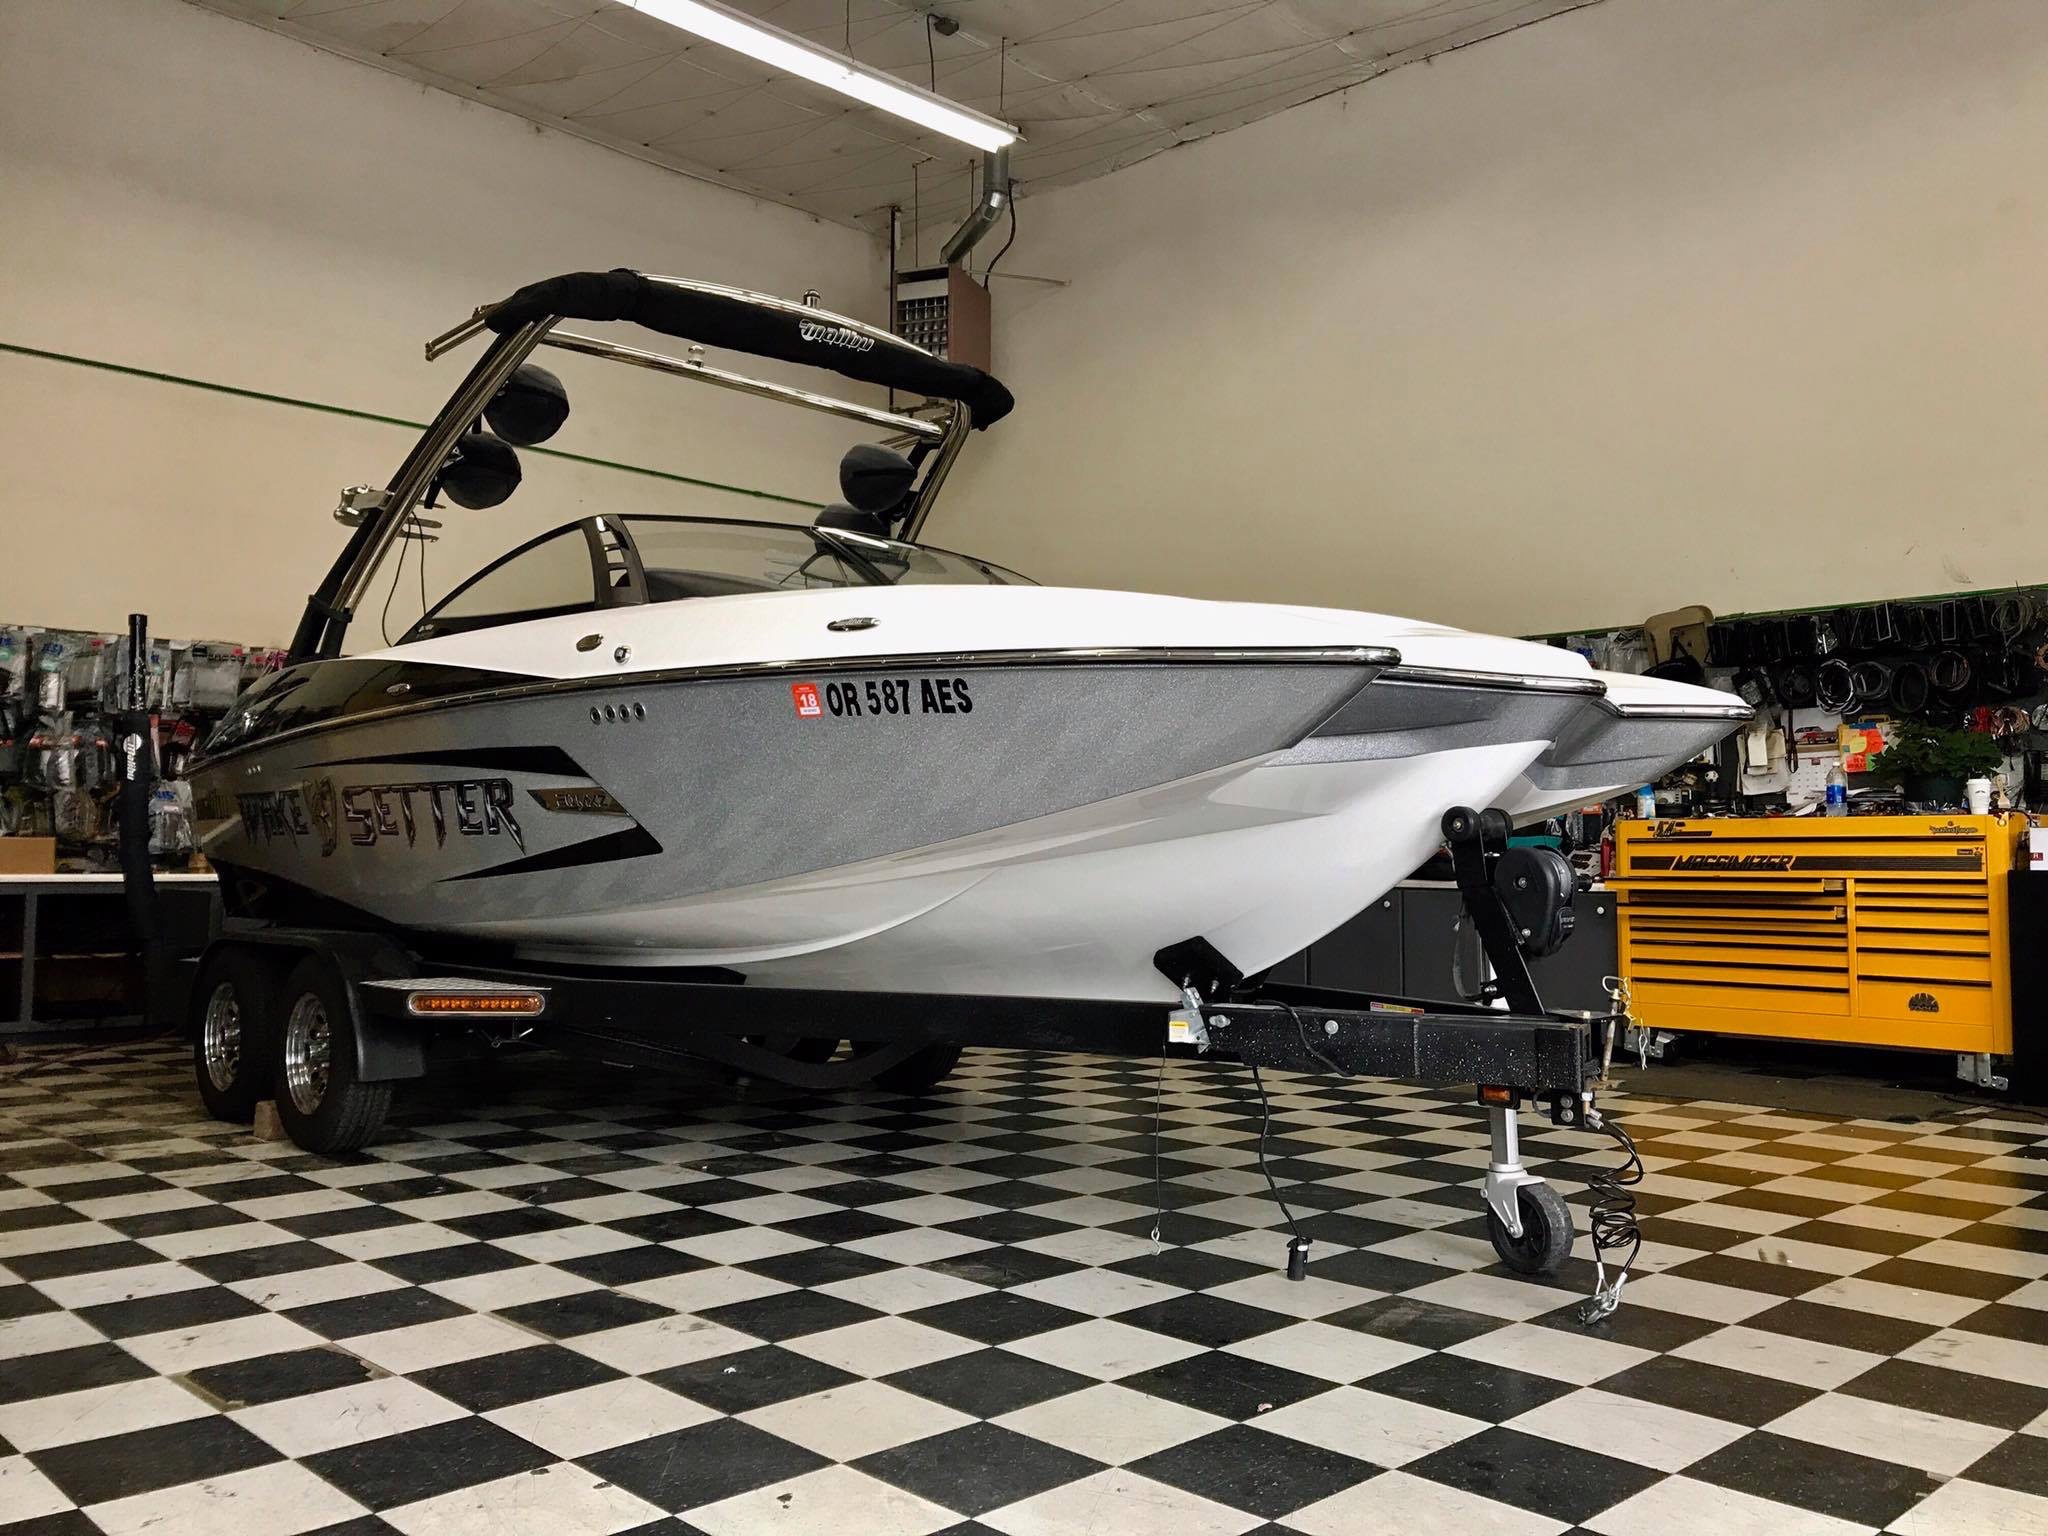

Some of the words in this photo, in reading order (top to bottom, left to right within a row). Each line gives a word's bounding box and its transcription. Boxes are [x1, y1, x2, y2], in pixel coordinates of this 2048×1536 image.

[800, 693, 818, 708] 18
[826, 682, 862, 717] OR
[865, 679, 911, 715] 587
[920, 677, 974, 714] AES
[341, 778, 526, 856] SETTER
